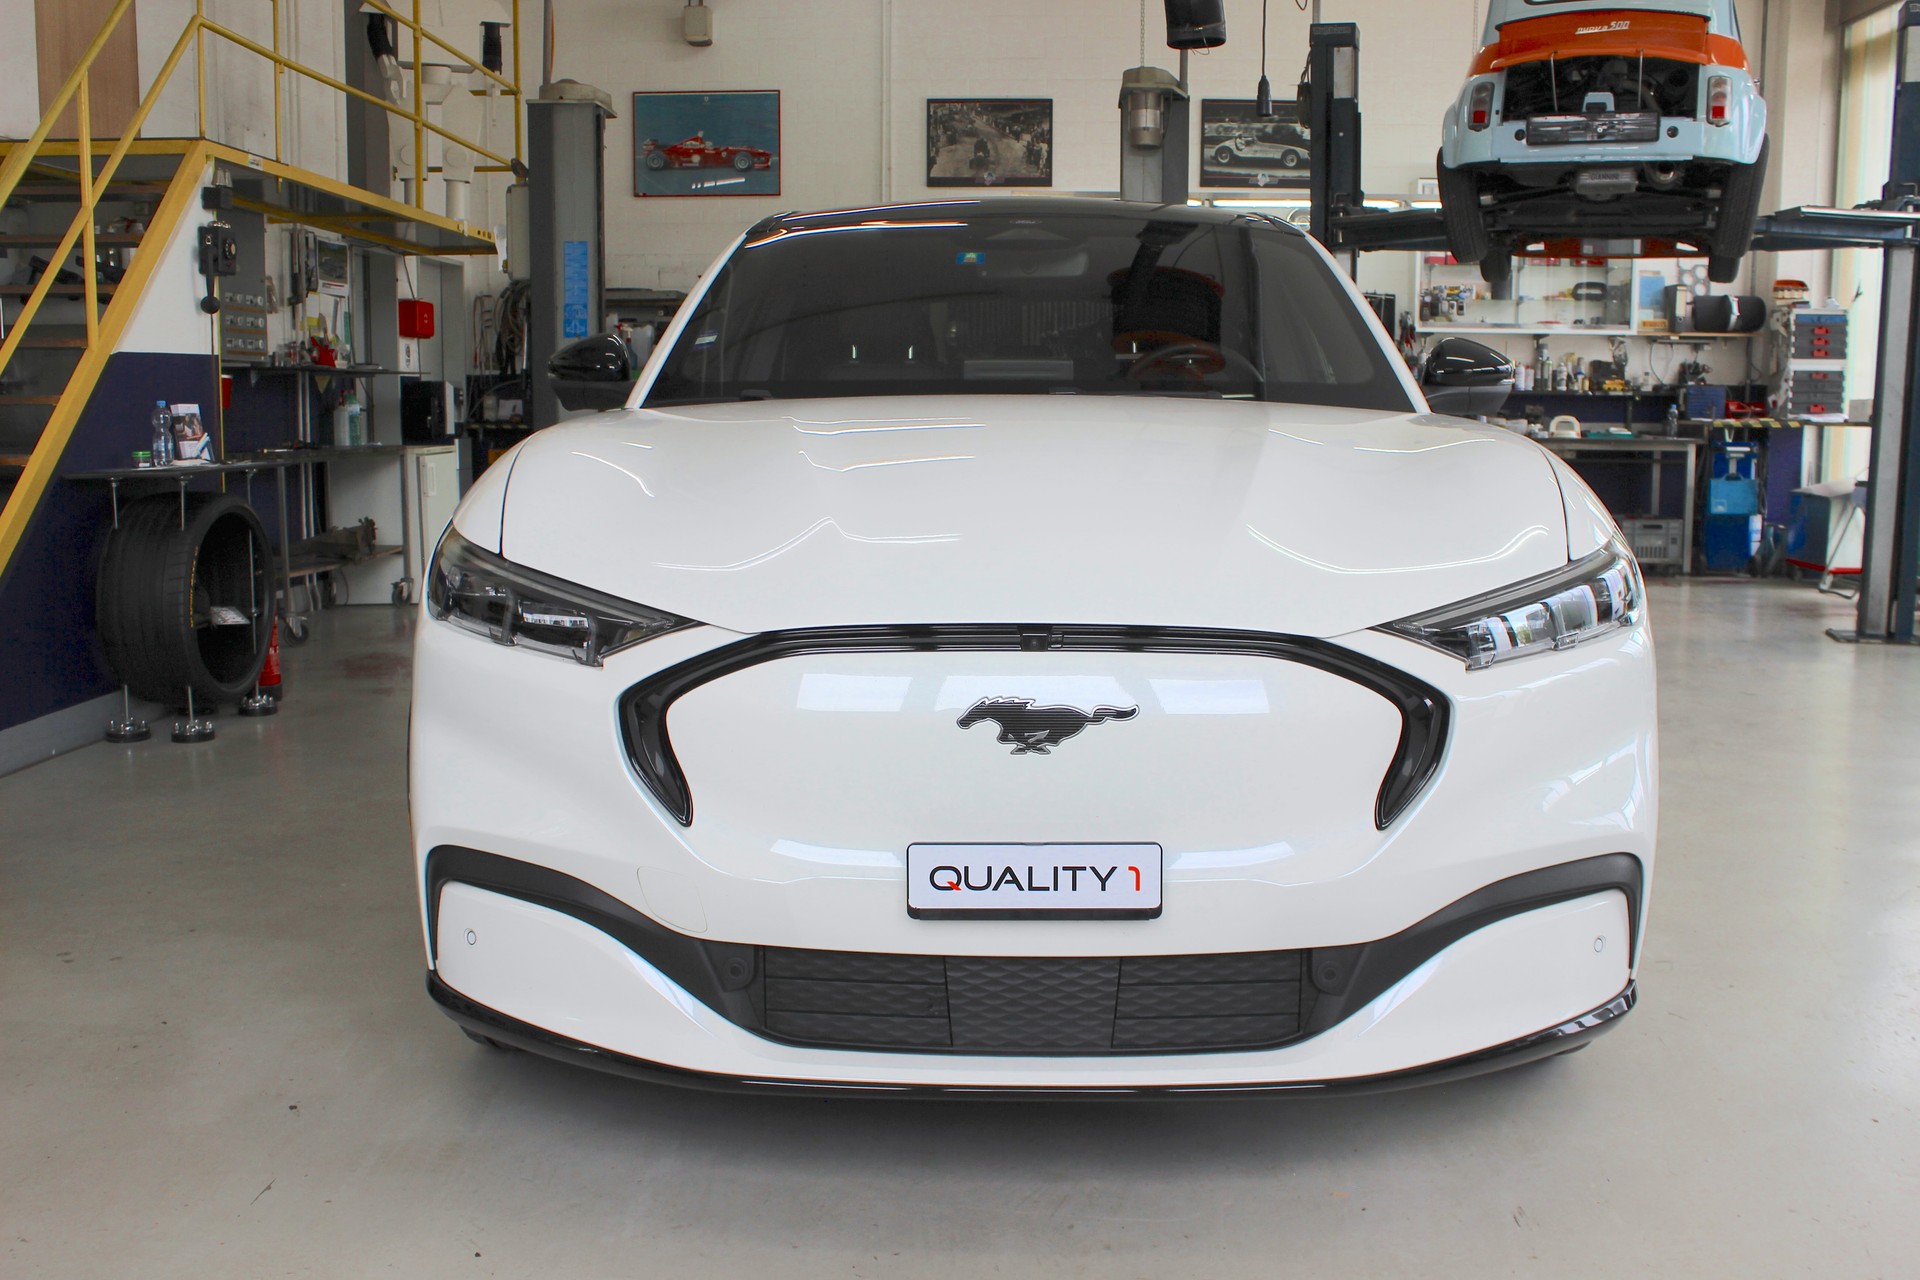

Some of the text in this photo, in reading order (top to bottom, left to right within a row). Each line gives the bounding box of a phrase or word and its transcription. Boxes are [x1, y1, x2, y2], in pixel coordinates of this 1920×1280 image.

[1610, 20, 1631, 31] 500
[929, 865, 1141, 892] QUALITY 1
